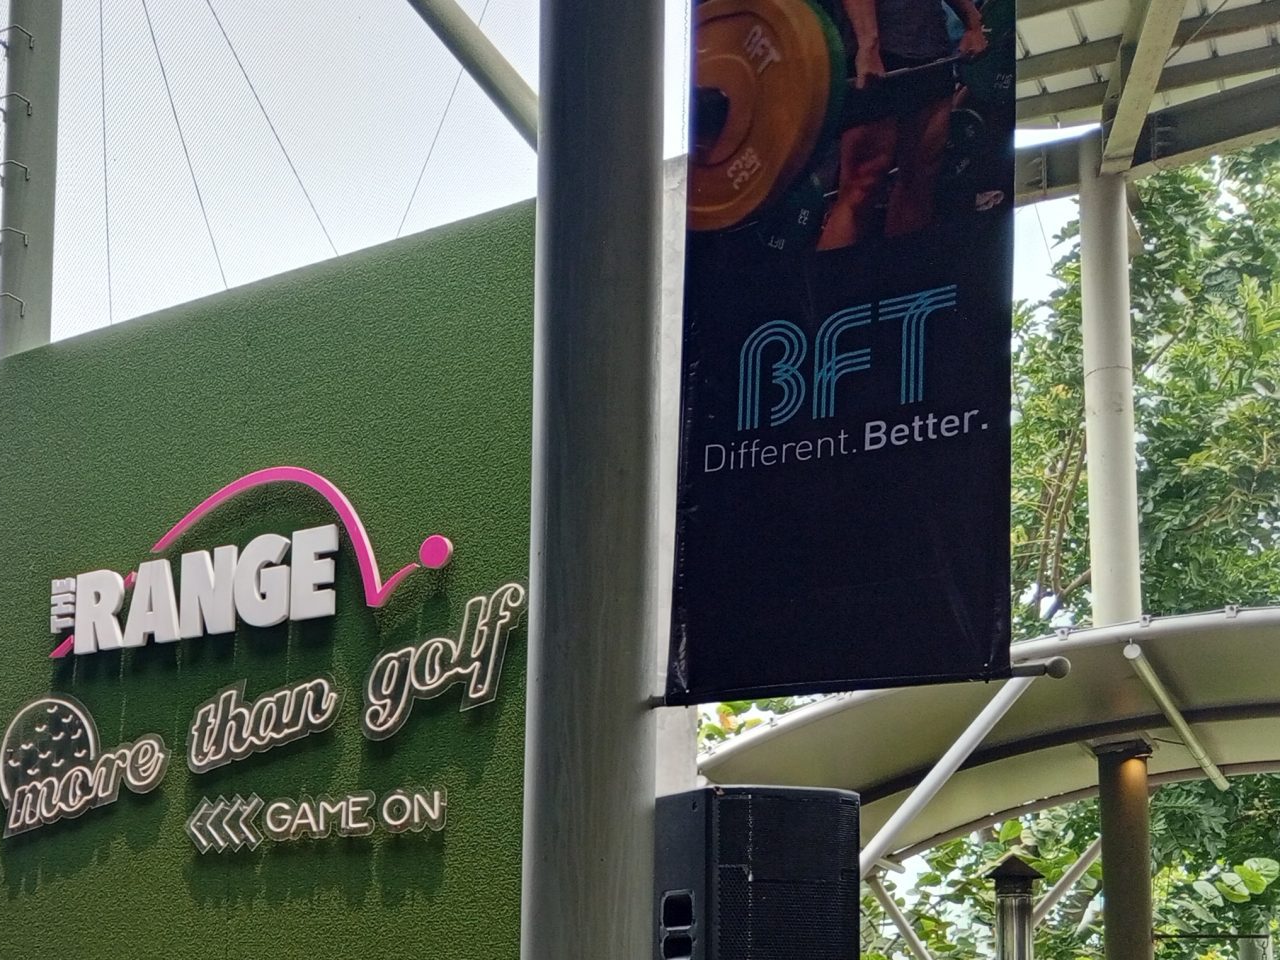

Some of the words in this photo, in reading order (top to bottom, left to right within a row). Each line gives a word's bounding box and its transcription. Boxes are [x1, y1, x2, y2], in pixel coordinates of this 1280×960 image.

[737, 284, 957, 431] BFT
[704, 428, 857, 472] Different.
[864, 408, 989, 450] Better.
[51, 577, 76, 633] THE
[73, 524, 339, 655] RANGE
[9, 738, 165, 830] more
[193, 677, 337, 767] than
[367, 583, 524, 732] golf
[266, 798, 367, 836] GAME
[383, 792, 442, 826] ON
